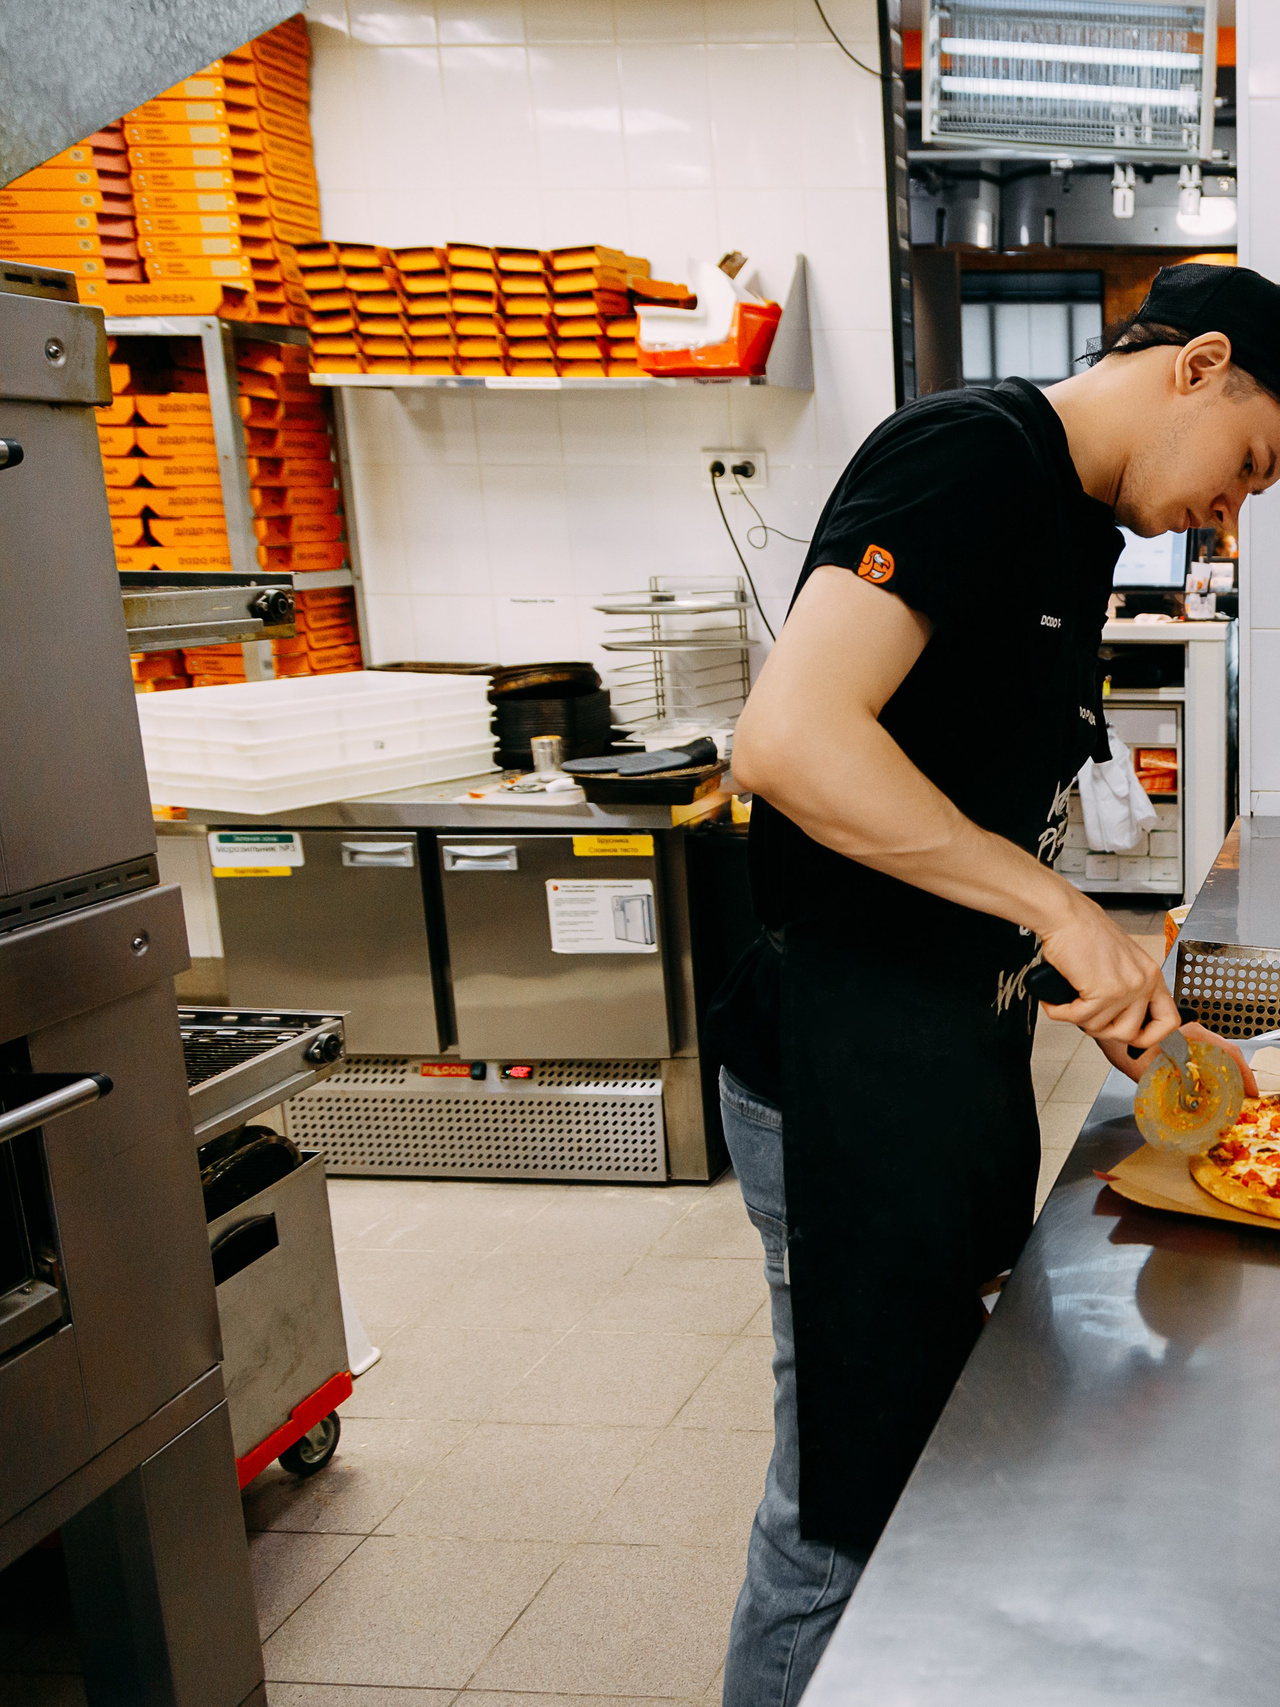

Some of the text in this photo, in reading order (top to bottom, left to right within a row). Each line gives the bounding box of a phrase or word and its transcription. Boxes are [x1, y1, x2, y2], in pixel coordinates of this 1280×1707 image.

[126, 294, 196, 303] DODO PIZZA
[216, 845, 276, 854] Морозильник
